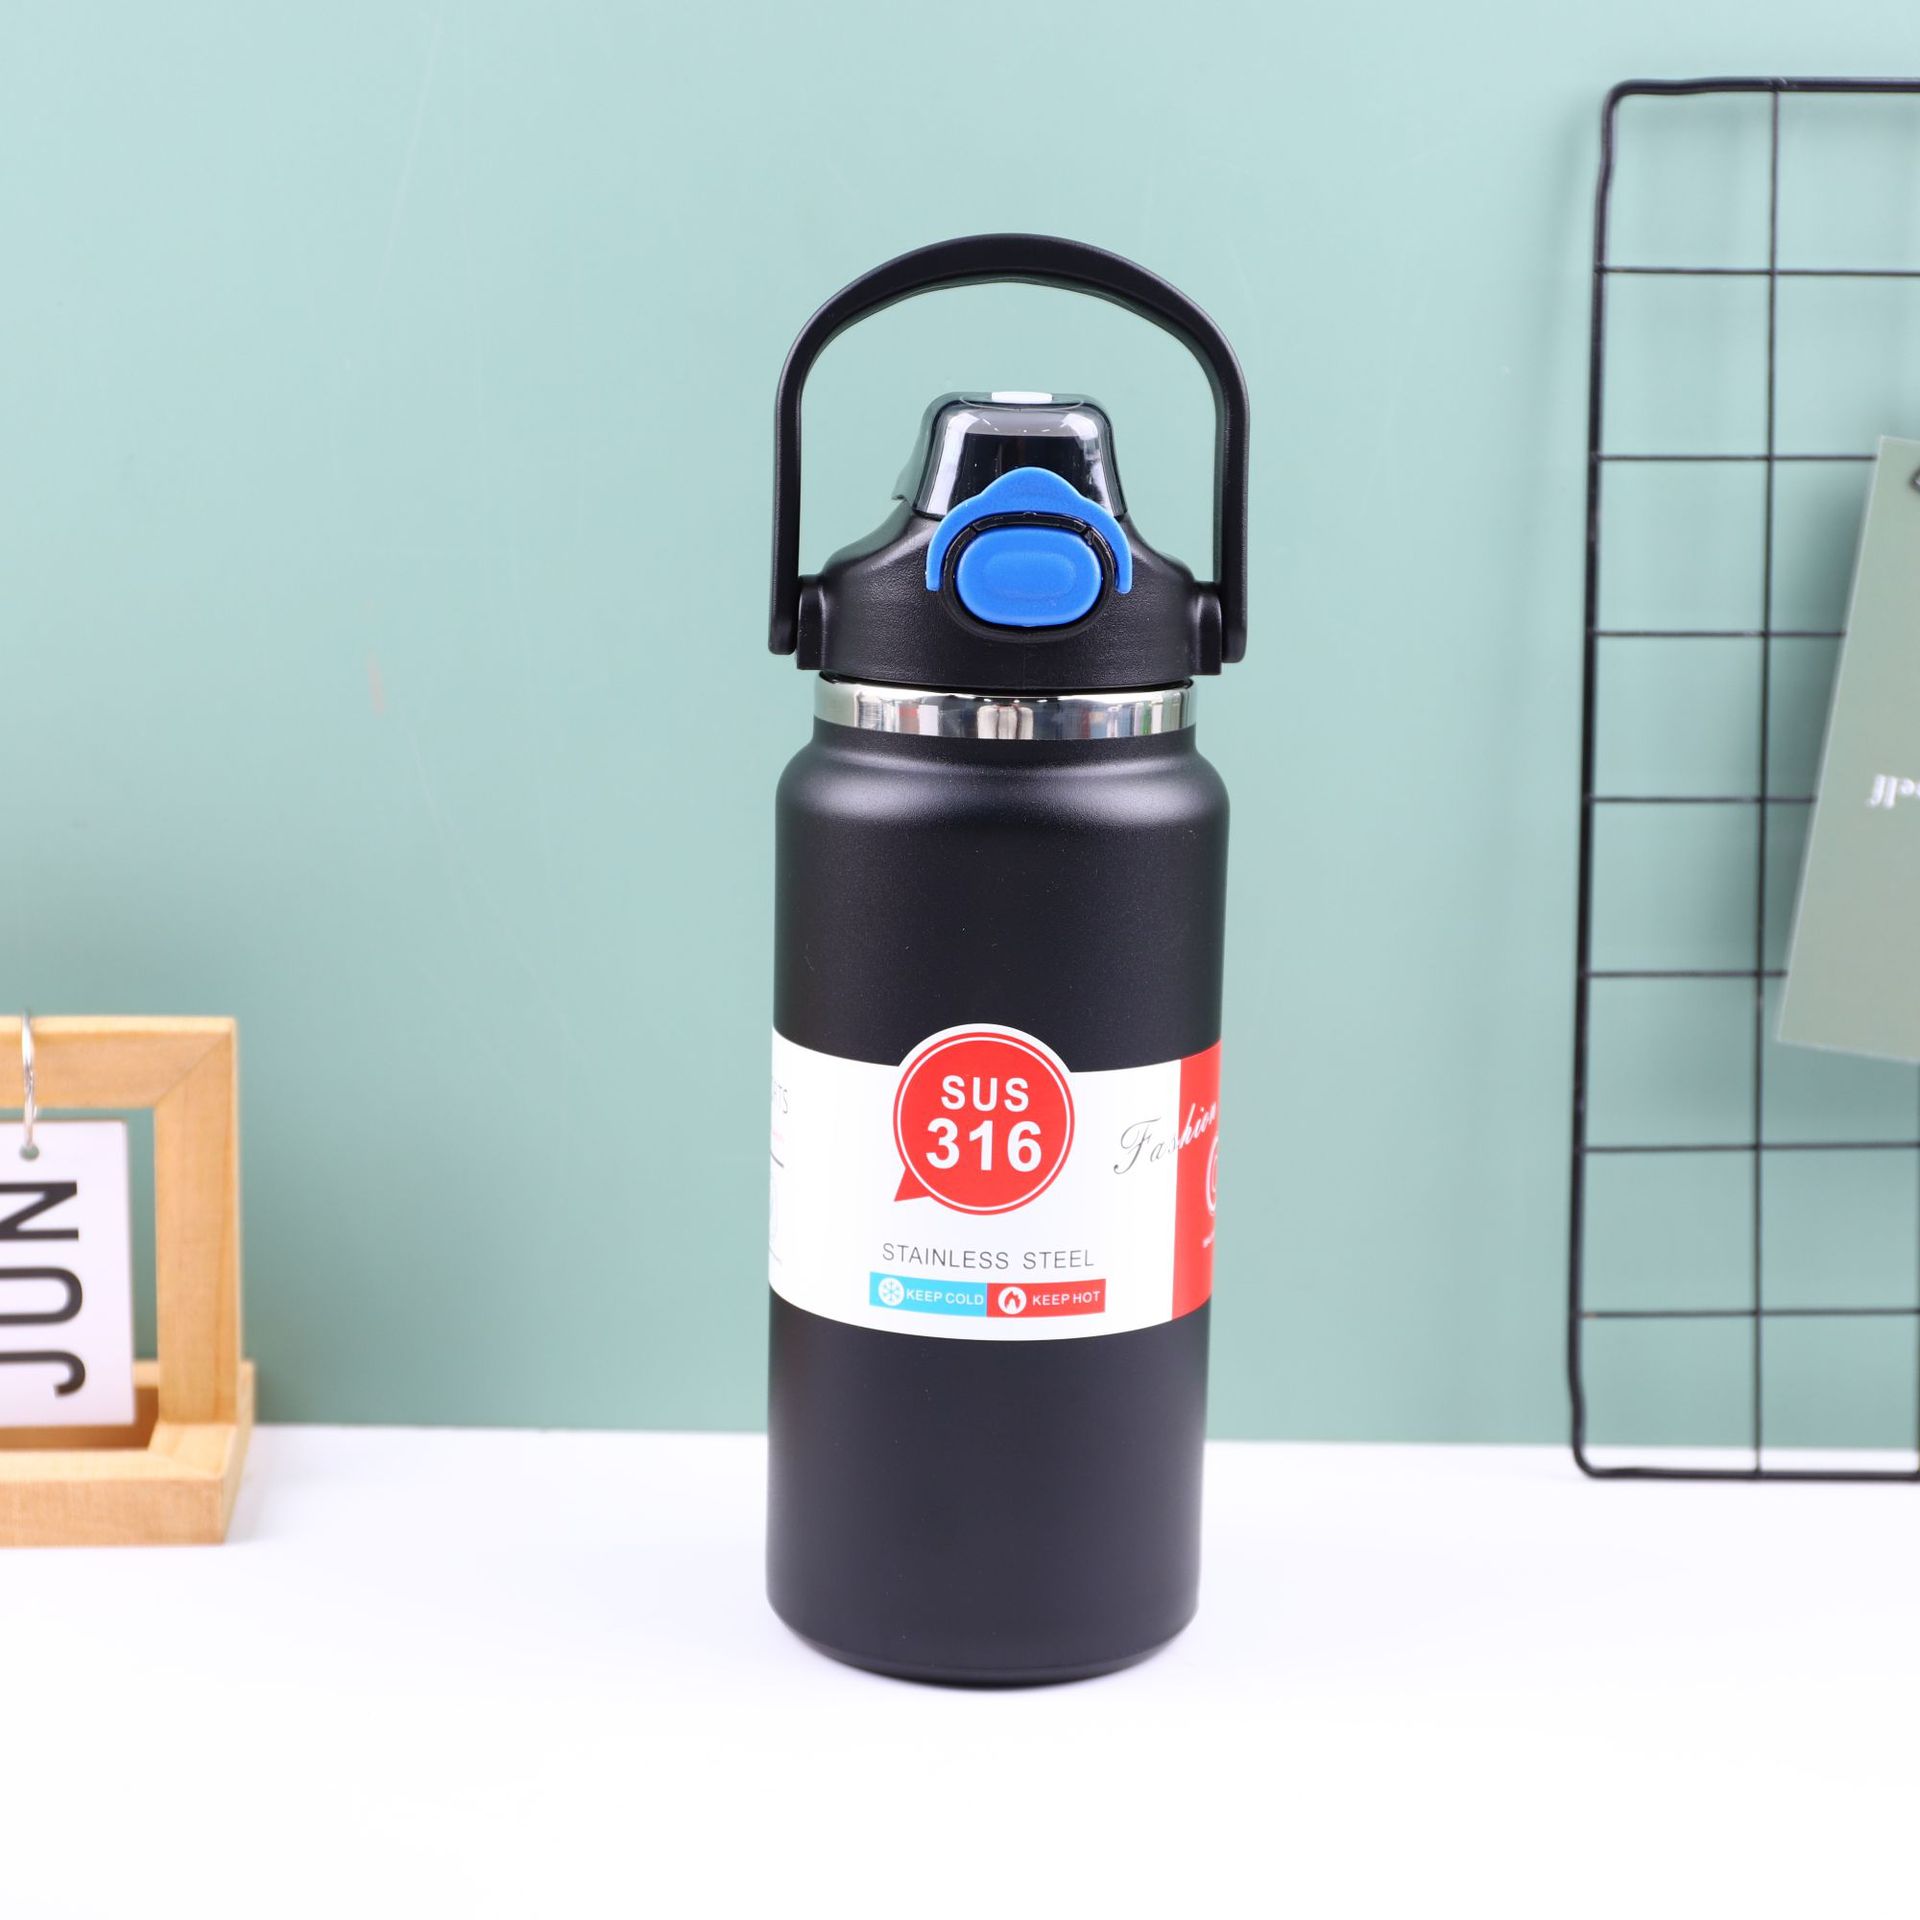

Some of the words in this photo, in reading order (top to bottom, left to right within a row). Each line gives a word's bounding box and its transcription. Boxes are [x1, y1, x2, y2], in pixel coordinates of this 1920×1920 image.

[940, 1075, 1029, 1112] SUS
[926, 1117, 1042, 1173] 316
[882, 1242, 1009, 1269] STAINLESS
[1023, 1249, 1095, 1269] STEEL
[0, 1181, 86, 1396] JUN
[906, 1287, 942, 1304] KEEP
[945, 1292, 984, 1306] COLD
[1032, 1294, 1070, 1306] KEEP
[1073, 1290, 1101, 1304] HOT
